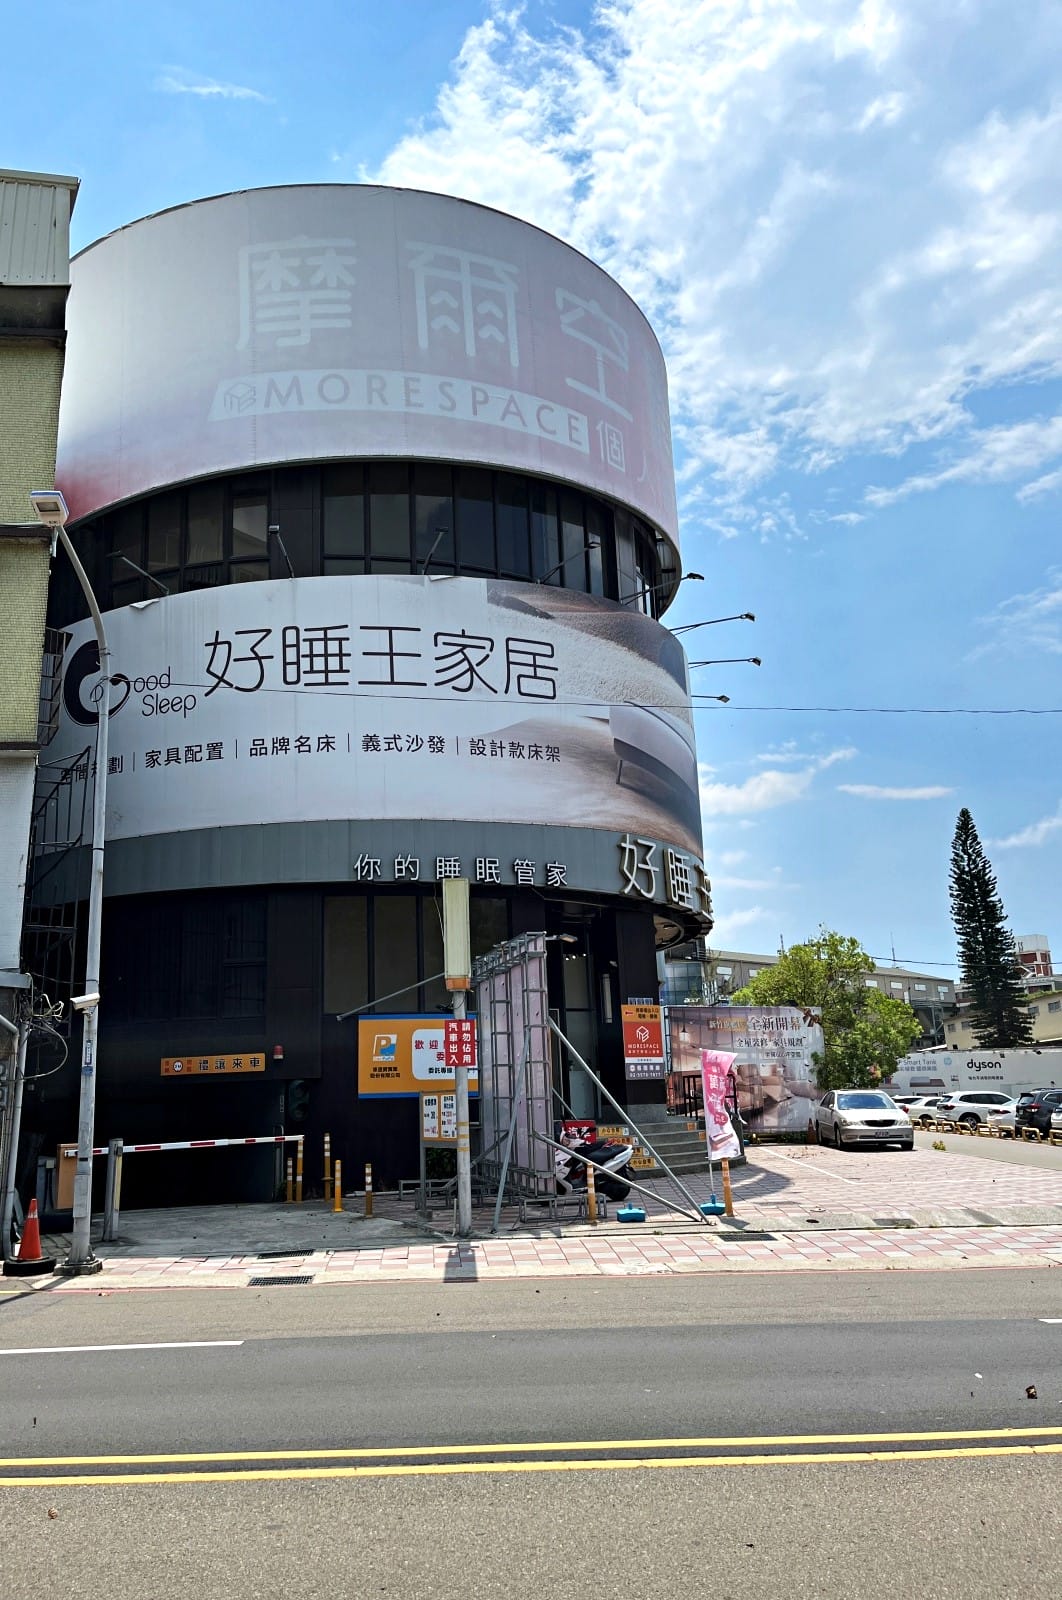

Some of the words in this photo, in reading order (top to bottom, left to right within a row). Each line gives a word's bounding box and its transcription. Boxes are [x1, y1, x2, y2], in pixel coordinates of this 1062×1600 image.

[264, 373, 583, 447] MORESPACE
[205, 624, 558, 700] 好睡王家居
[141, 693, 197, 719] Sleep
[145, 742, 224, 768] 家具配置
[249, 734, 336, 757] 品牌名床
[361, 733, 446, 754] 義式沙發
[469, 738, 561, 762] 設計款床架
[354, 853, 568, 886] 你的睡眠管家
[750, 1015, 801, 1031] 全新開幕
[448, 1022, 458, 1064] 汽車出入
[461, 1022, 471, 1063] 請勿佔用
[967, 1058, 1002, 1072] dyson
